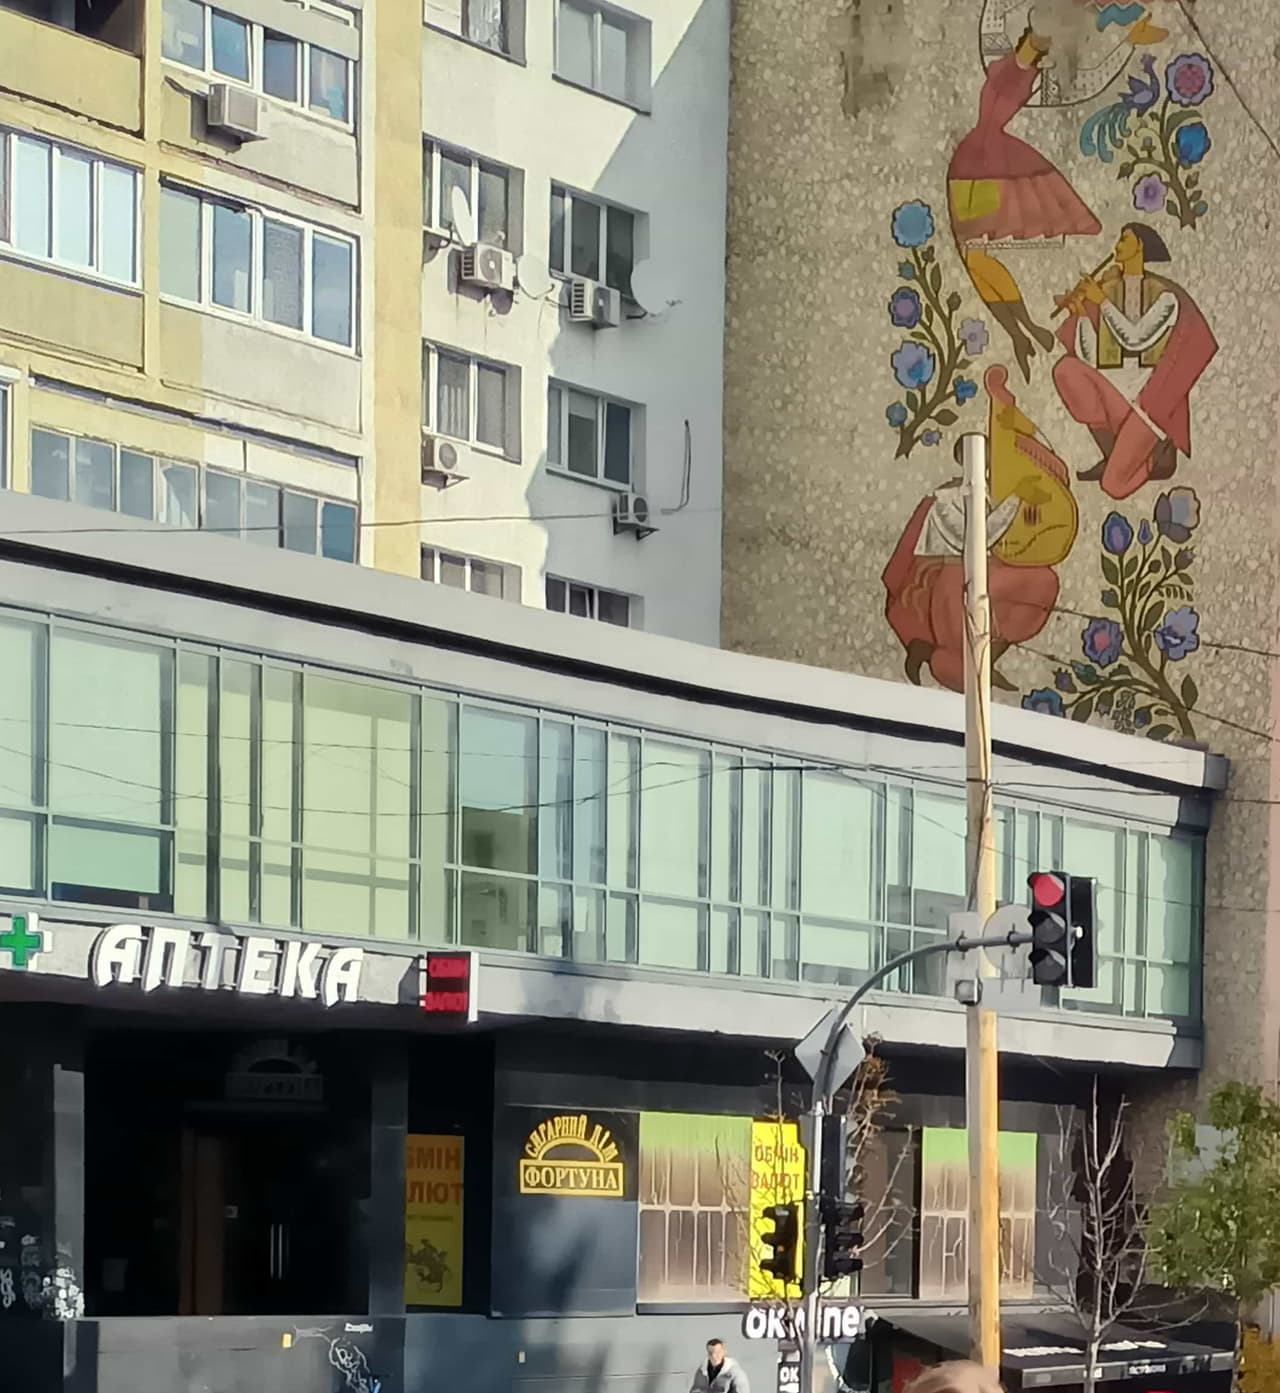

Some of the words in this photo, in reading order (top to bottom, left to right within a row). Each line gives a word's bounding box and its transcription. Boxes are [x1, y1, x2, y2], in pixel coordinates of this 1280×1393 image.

[96, 925, 363, 1007] АПТЕКА
[589, 1124, 618, 1160] ДІМ
[525, 1166, 617, 1189] ФОРТУНА
